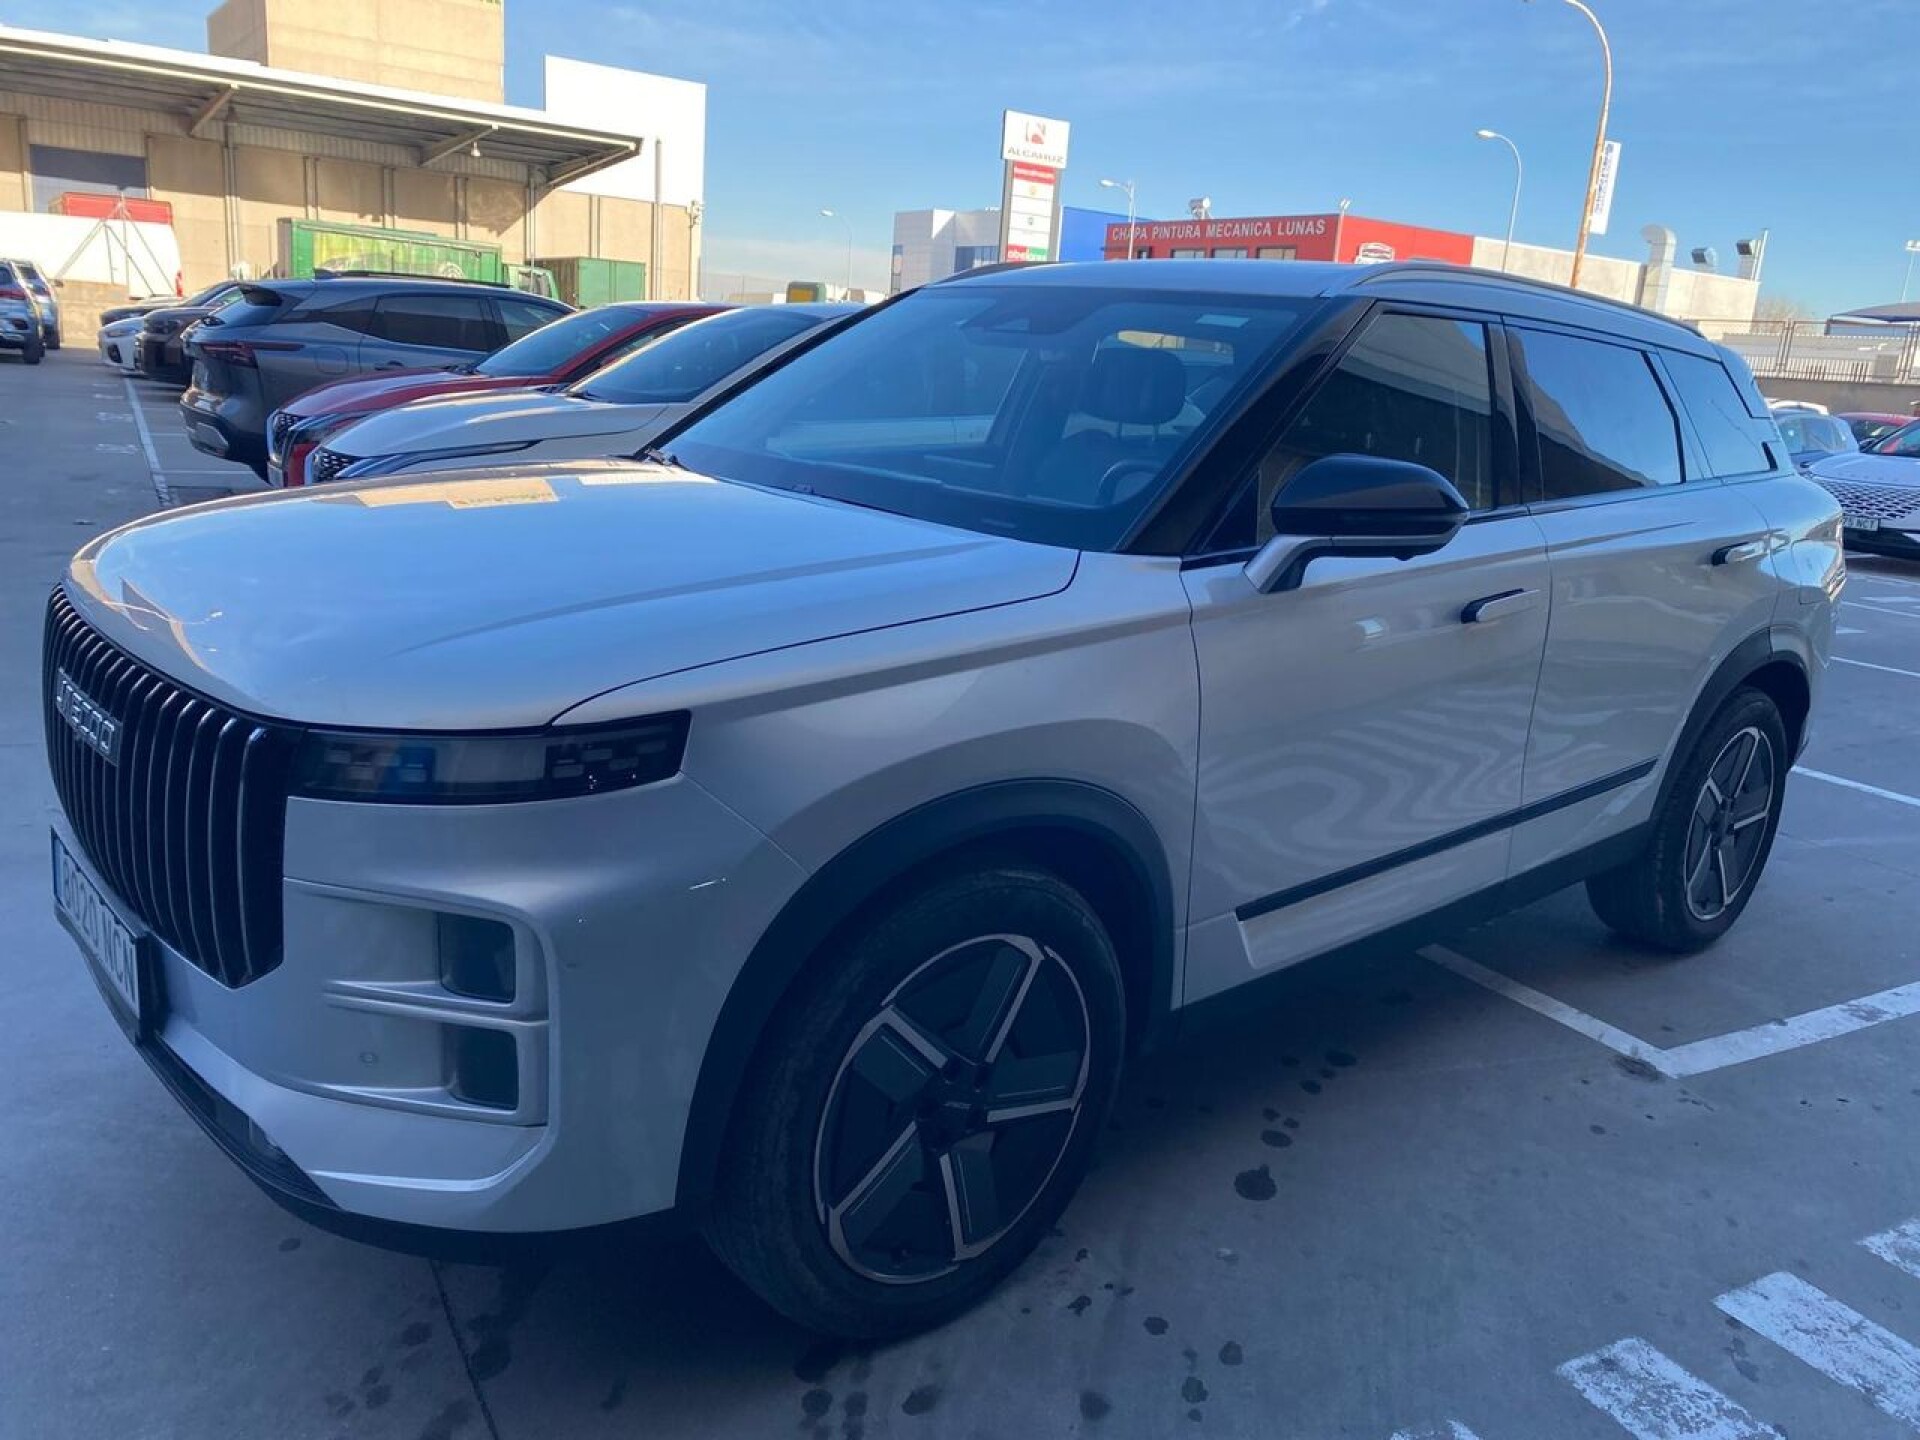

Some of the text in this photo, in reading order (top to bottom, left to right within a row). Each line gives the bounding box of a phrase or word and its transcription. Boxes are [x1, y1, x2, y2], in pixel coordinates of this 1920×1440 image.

[1112, 219, 1326, 241] CHAPA PINTURA MECANICA LUNAS
